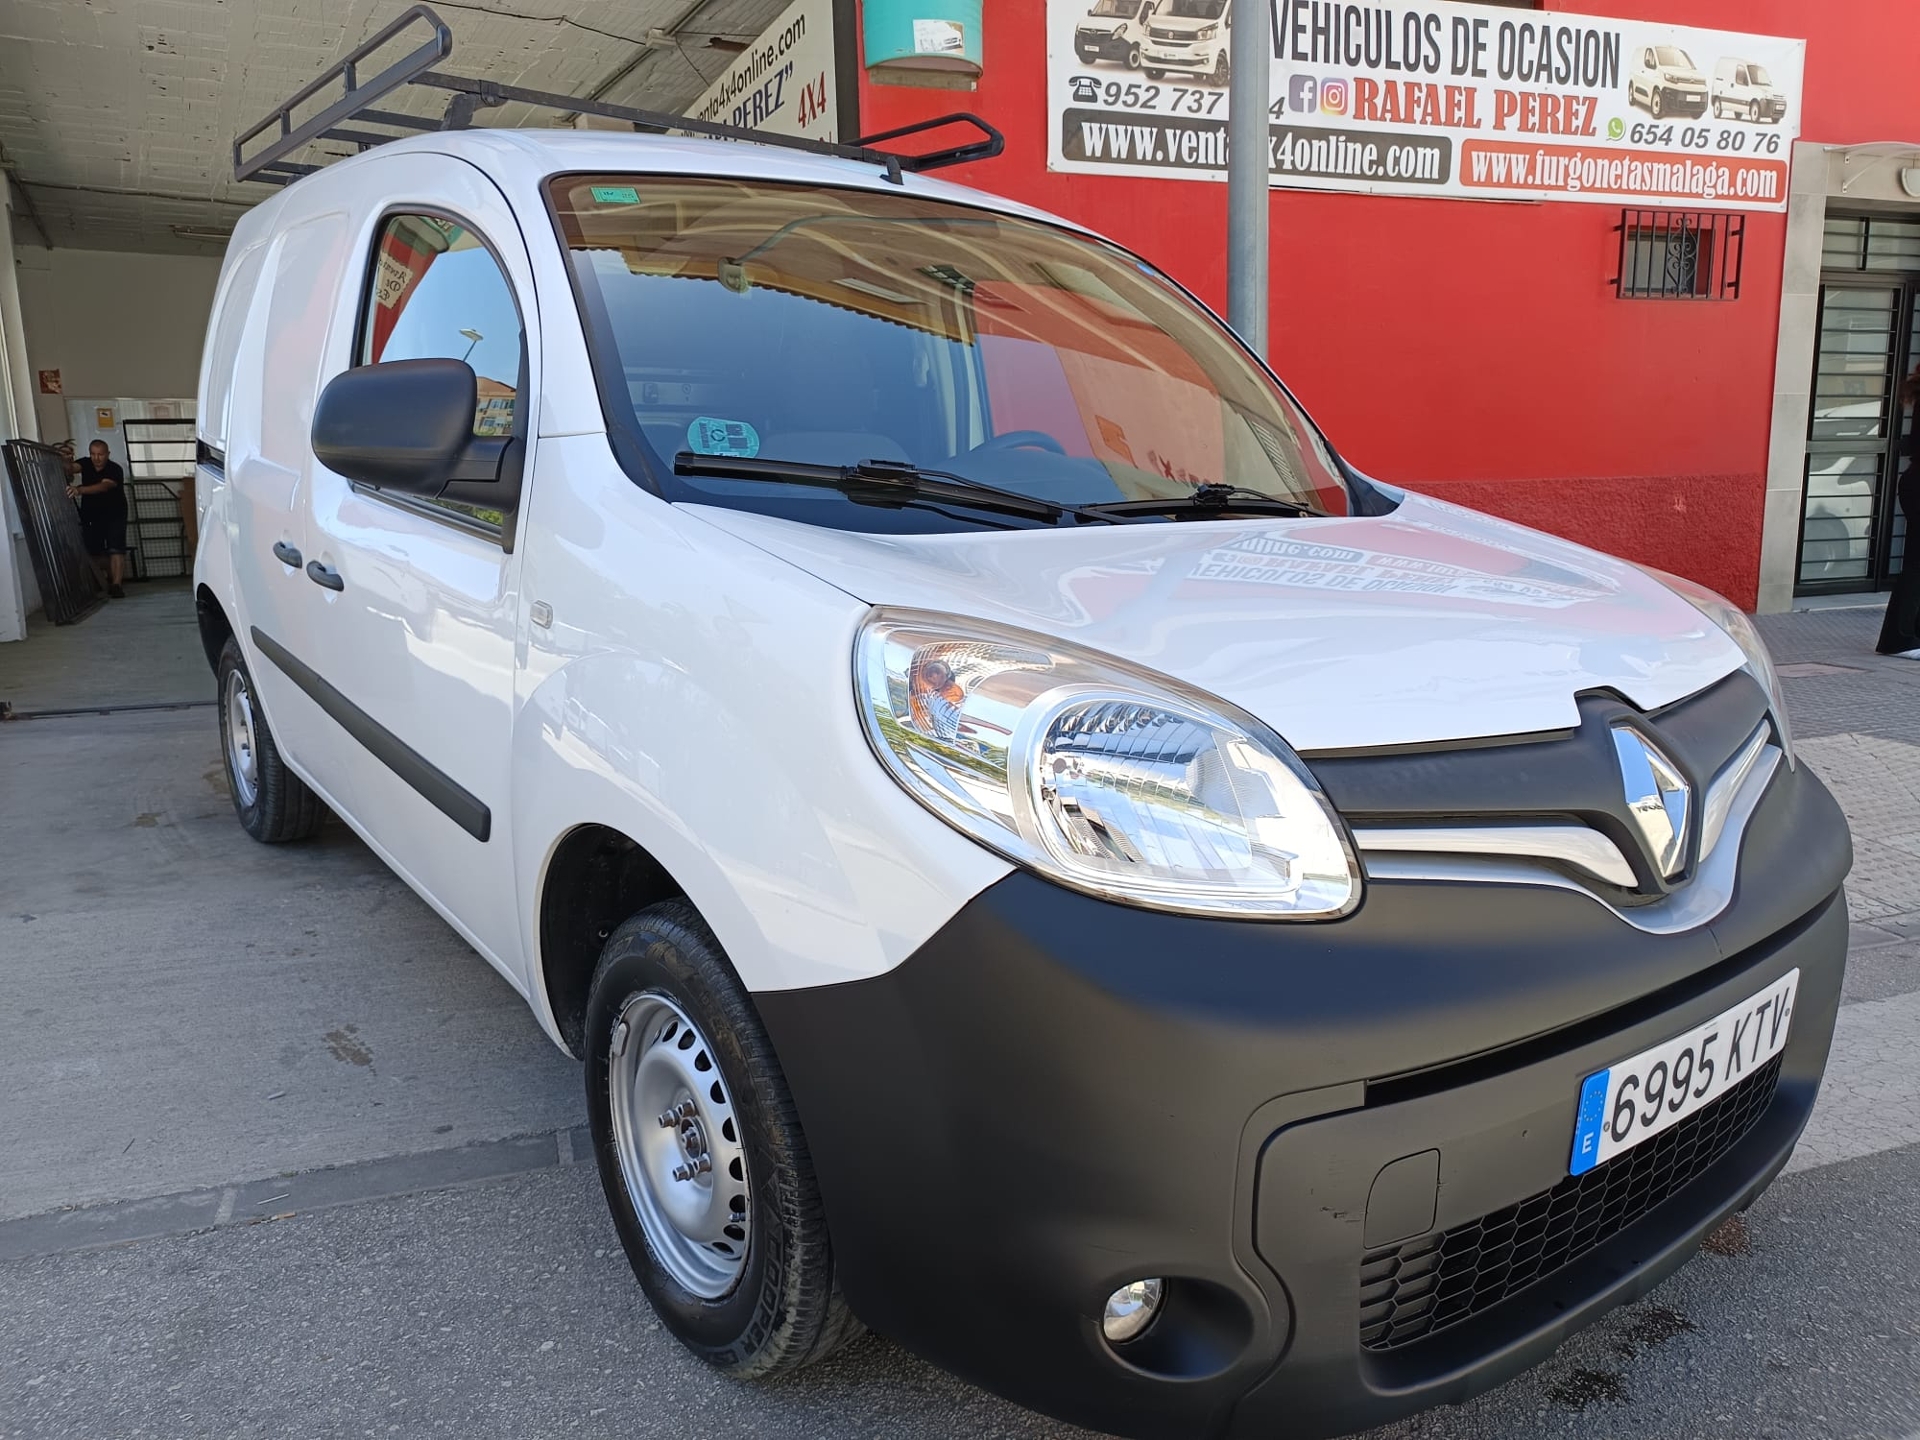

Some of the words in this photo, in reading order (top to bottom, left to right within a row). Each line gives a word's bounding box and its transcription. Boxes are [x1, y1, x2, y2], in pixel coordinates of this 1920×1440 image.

[697, 14, 805, 122] enta4x4online.com
[1269, 0, 1441, 75] VEHICULOS
[1450, 16, 1489, 78] DE
[1497, 20, 1620, 89] OCASION
[1103, 81, 1161, 110] 952
[1171, 87, 1224, 115] 737
[1353, 77, 1481, 129] RAFAEL
[1493, 89, 1598, 136] PEREZ
[1081, 121, 1440, 179] www.ventx4online.com
[1629, 123, 1673, 146] 654
[1680, 126, 1711, 149] 05
[1716, 129, 1745, 151] 80
[1752, 132, 1781, 153] 76
[1471, 150, 1777, 198] www.furgonetasmalaga.com
[1611, 1032, 1719, 1142] 6995
[1724, 987, 1790, 1081] KTV
[1581, 1131, 1595, 1154] E
